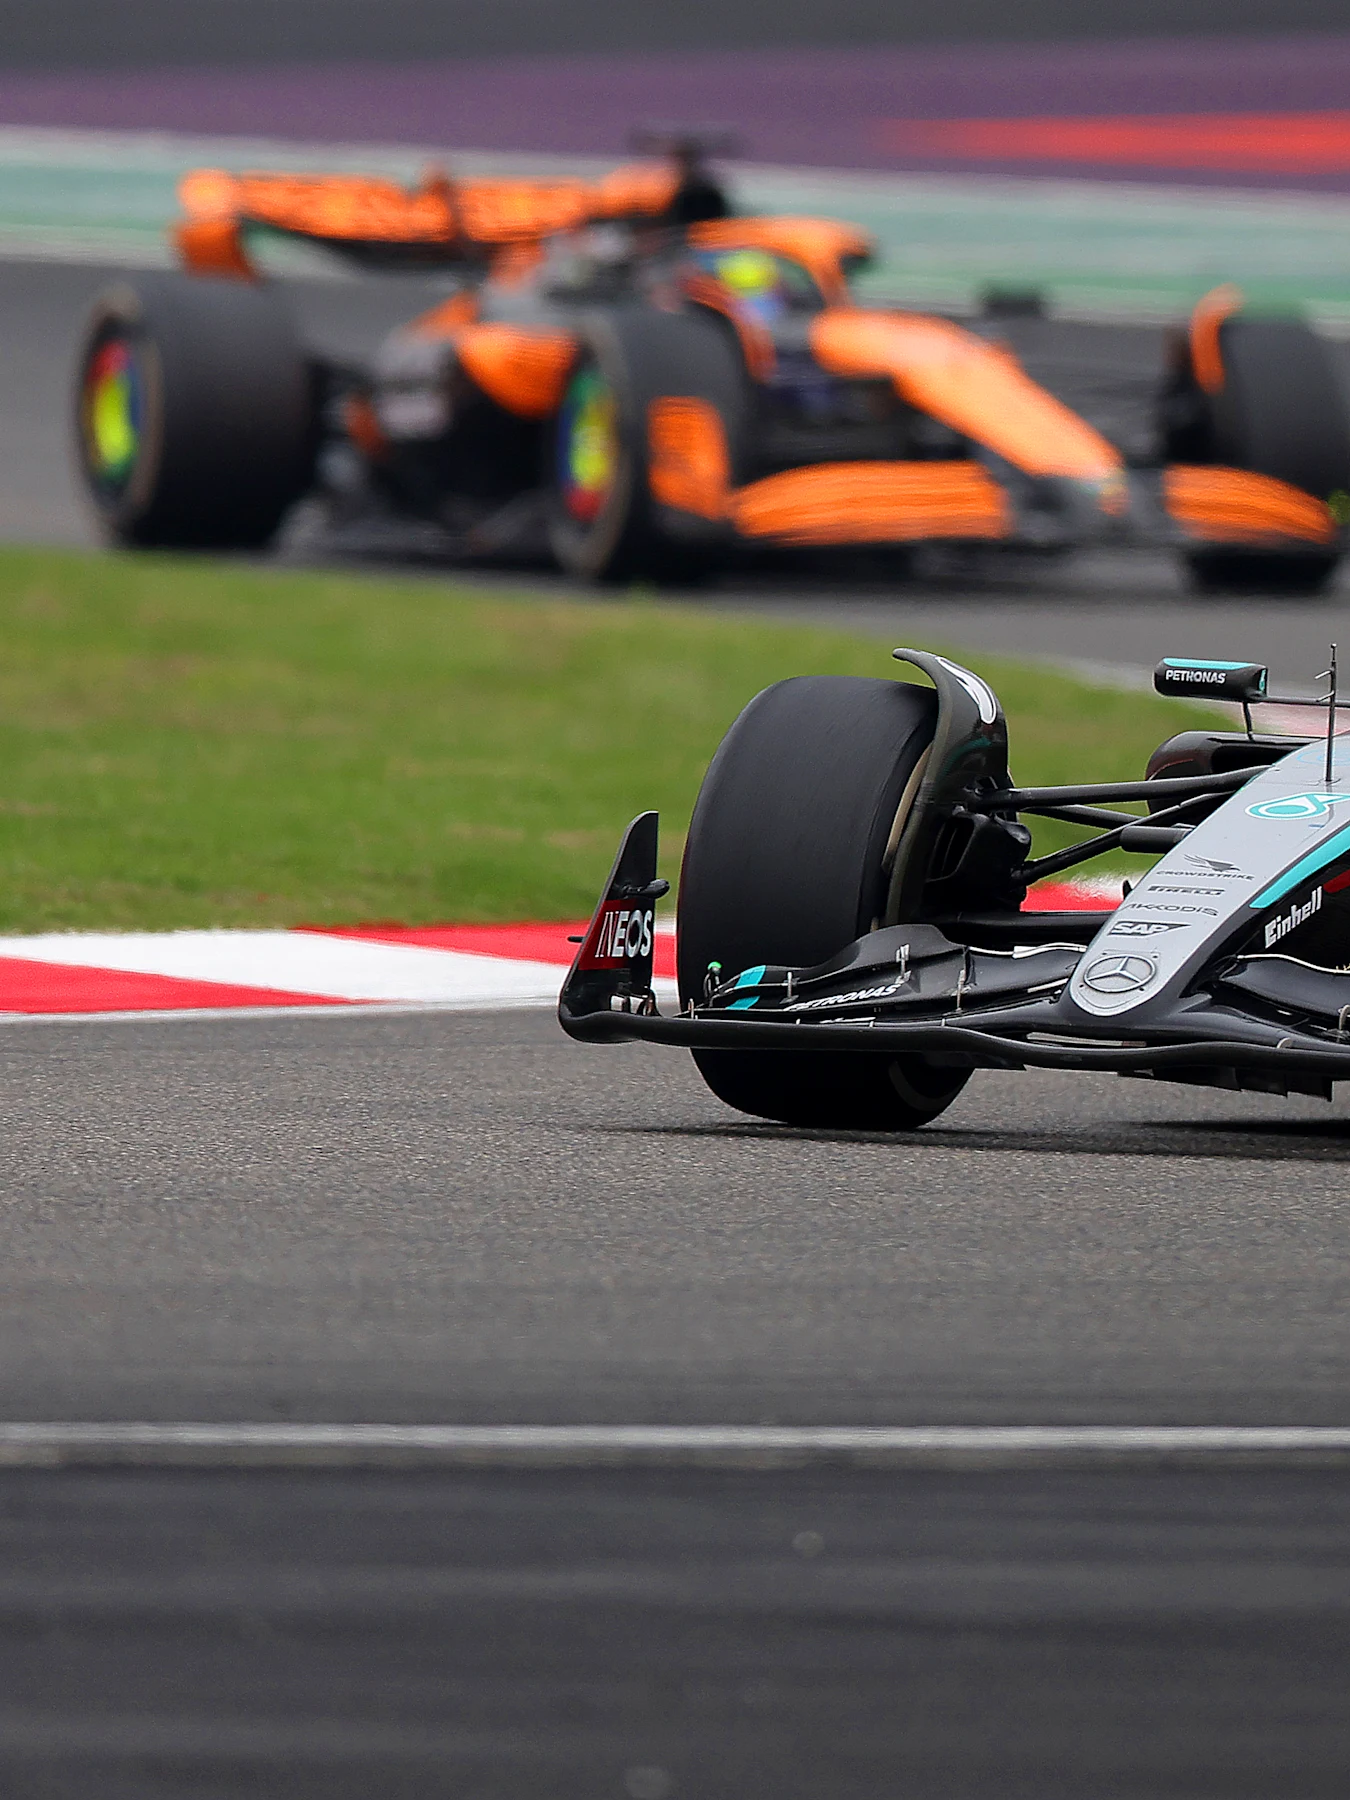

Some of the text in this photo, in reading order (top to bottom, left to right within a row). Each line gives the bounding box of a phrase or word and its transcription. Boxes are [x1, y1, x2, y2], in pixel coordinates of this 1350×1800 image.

[1165, 669, 1227, 684] PETRONAS
[1156, 870, 1255, 881] CROWDSTRIKE
[1265, 886, 1323, 949] Einhell
[595, 909, 653, 958] INEOS
[1110, 922, 1170, 936] SAP
